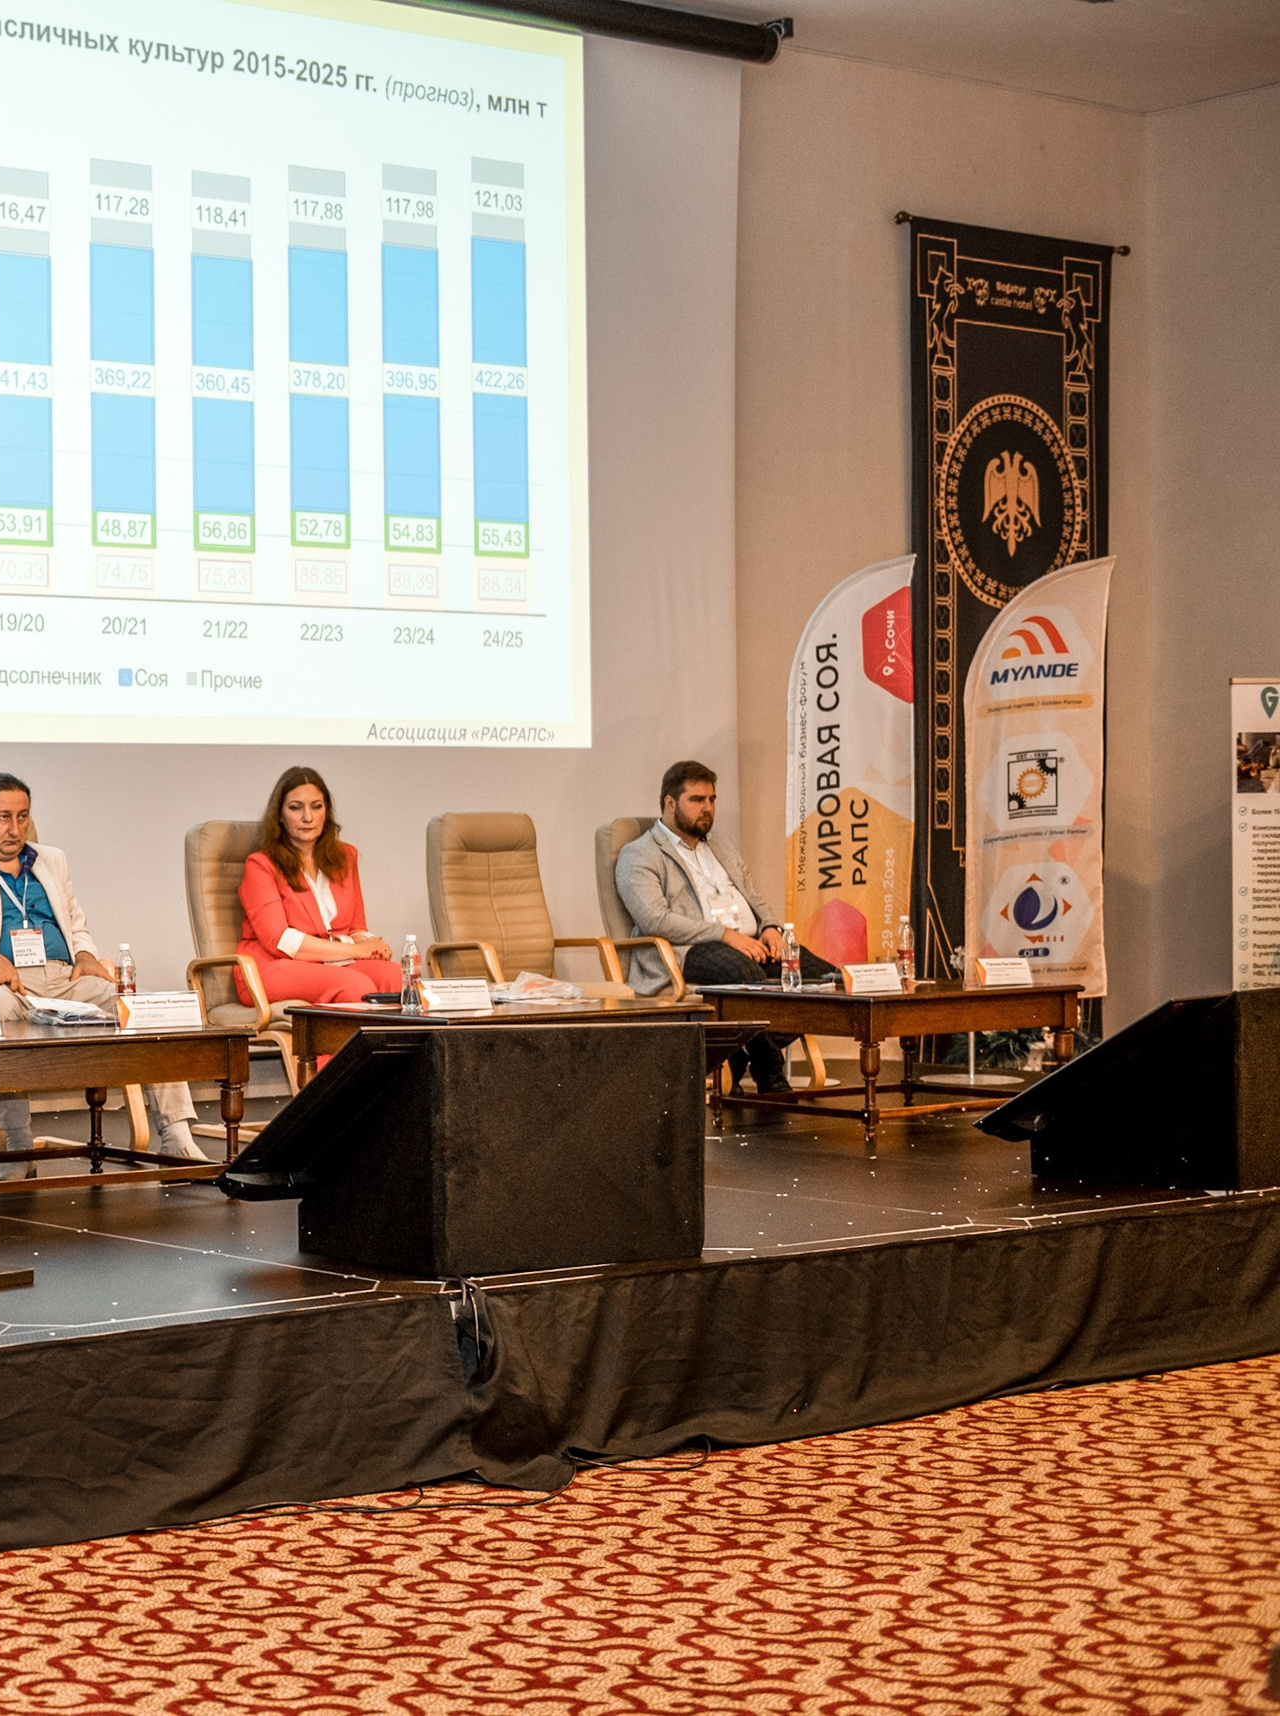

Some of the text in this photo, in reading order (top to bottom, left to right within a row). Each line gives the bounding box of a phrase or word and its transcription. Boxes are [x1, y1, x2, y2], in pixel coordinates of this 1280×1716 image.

[128, 37, 224, 74] культур
[233, 48, 348, 88] 2015-2025
[354, 71, 378, 94] гг.
[384, 74, 481, 113] (прогноз),
[487, 93, 531, 117] млн
[536, 101, 548, 119] т
[94, 192, 150, 217] 117,28
[195, 204, 248, 228] 118,41
[292, 198, 344, 221] 117,88
[385, 196, 435, 220] 117,98
[473, 189, 523, 213] 121,03
[93, 366, 153, 391] 369,22
[195, 372, 251, 396] 360,45
[291, 368, 346, 392] 378,20
[385, 369, 438, 393] 396,95
[474, 369, 526, 393] 422,26
[99, 516, 149, 541] 48,87
[201, 519, 248, 543] 56,86
[298, 516, 344, 541] 52,78
[391, 521, 436, 546] 54,83
[481, 525, 523, 549] 55,43
[100, 560, 149, 584] 74,75
[202, 565, 248, 588] 75,83
[392, 570, 434, 592] 88,39
[482, 573, 523, 595] 88,34
[101, 615, 148, 636] 20/21
[202, 619, 248, 640] 21/22
[299, 622, 344, 643] 22/23
[393, 626, 435, 646] 23/24
[482, 629, 524, 649] 24/25
[885, 610, 896, 650] Сочи
[134, 668, 168, 688] Соя
[200, 669, 263, 692] Прочие
[990, 662, 1079, 686] MYANDE
[366, 722, 556, 744] Ассоциация «РАСРАПС»
[797, 661, 809, 893] IX Международный бизнес-форум
[816, 633, 842, 891] МИРОВАЯ СОЯ.
[850, 798, 869, 886] РАПС
[883, 848, 896, 889] 2024
[884, 893, 894, 925] мая
